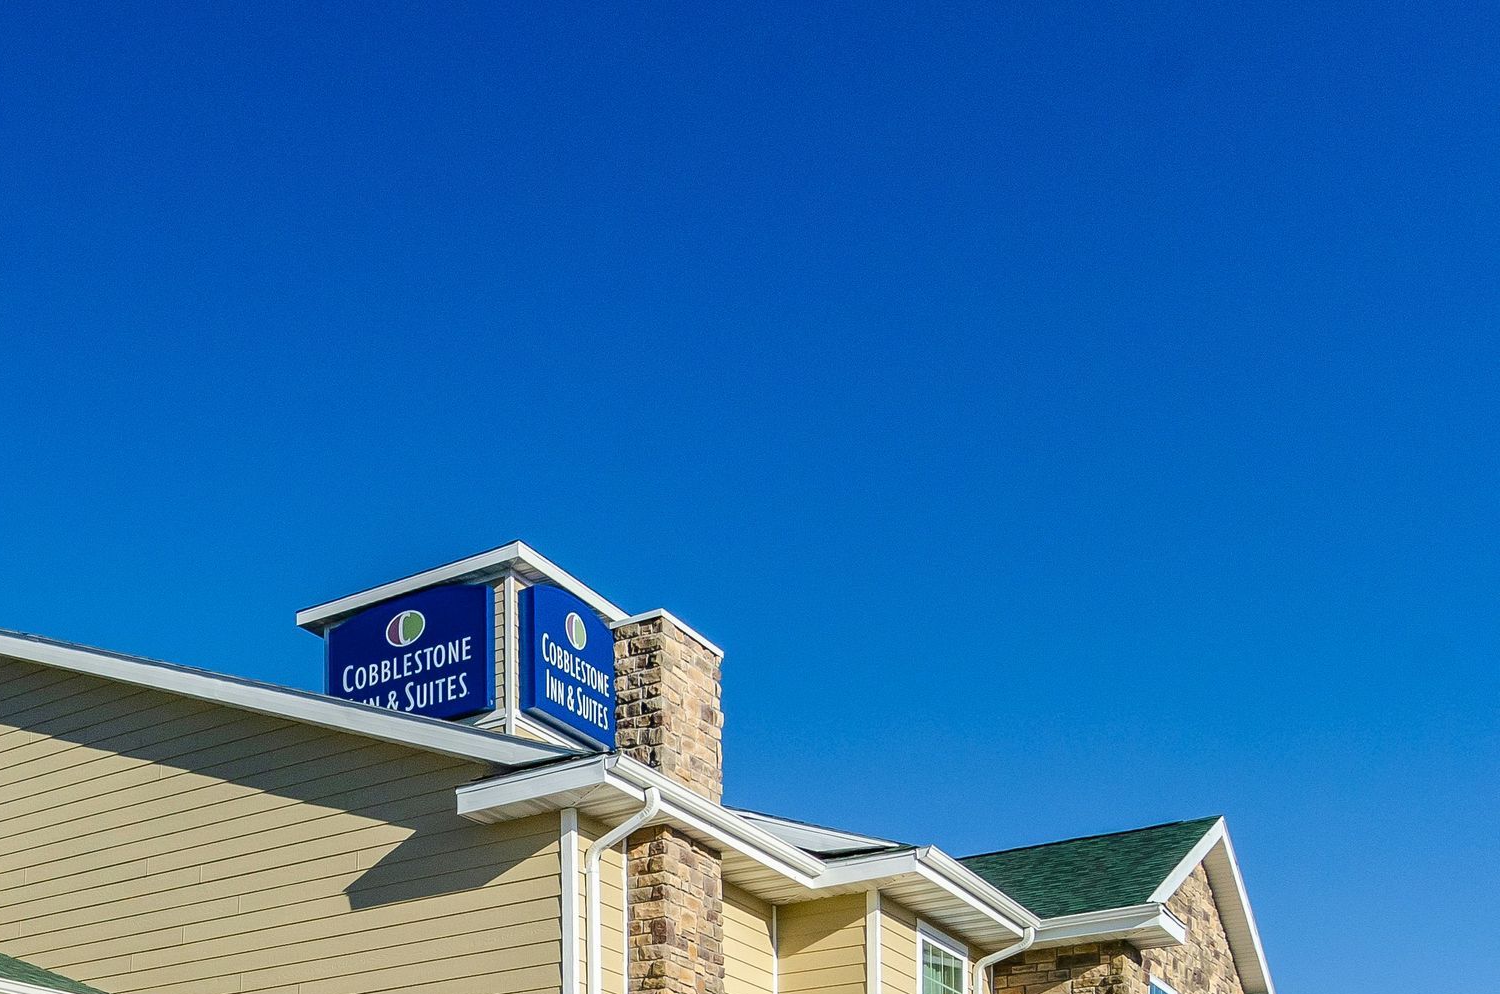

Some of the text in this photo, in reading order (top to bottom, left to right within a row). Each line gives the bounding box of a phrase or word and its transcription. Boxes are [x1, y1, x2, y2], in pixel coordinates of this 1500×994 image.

[342, 636, 472, 693] COBBLESTONE
[404, 672, 468, 712] SUITES
[542, 632, 610, 698] COBBLESTONE
[546, 668, 609, 730] INN & SUITES
